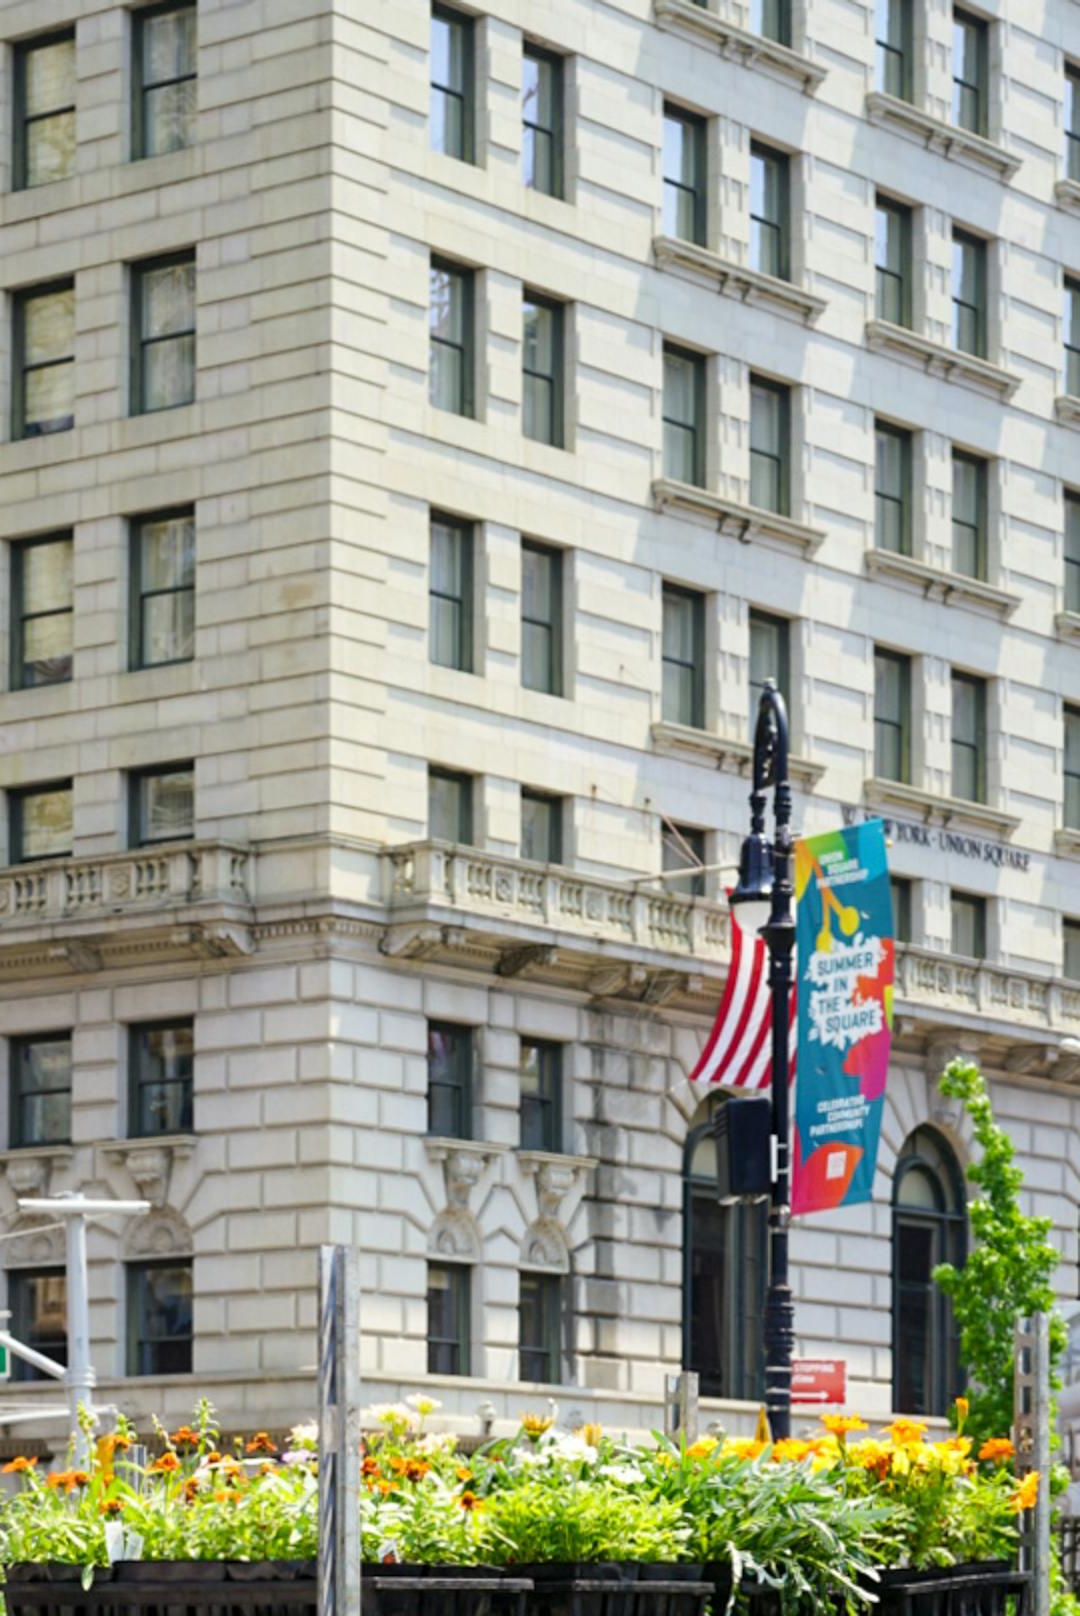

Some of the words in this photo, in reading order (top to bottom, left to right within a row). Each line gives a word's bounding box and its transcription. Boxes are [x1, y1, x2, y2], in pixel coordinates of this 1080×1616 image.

[895, 819, 931, 847] YORK
[938, 831, 982, 862] UNION
[984, 841, 1031, 872] SQUARE
[817, 952, 873, 976] SUMMER
[834, 976, 848, 992] IN
[818, 996, 839, 1014] THE
[826, 1009, 875, 1034] SQUARE
